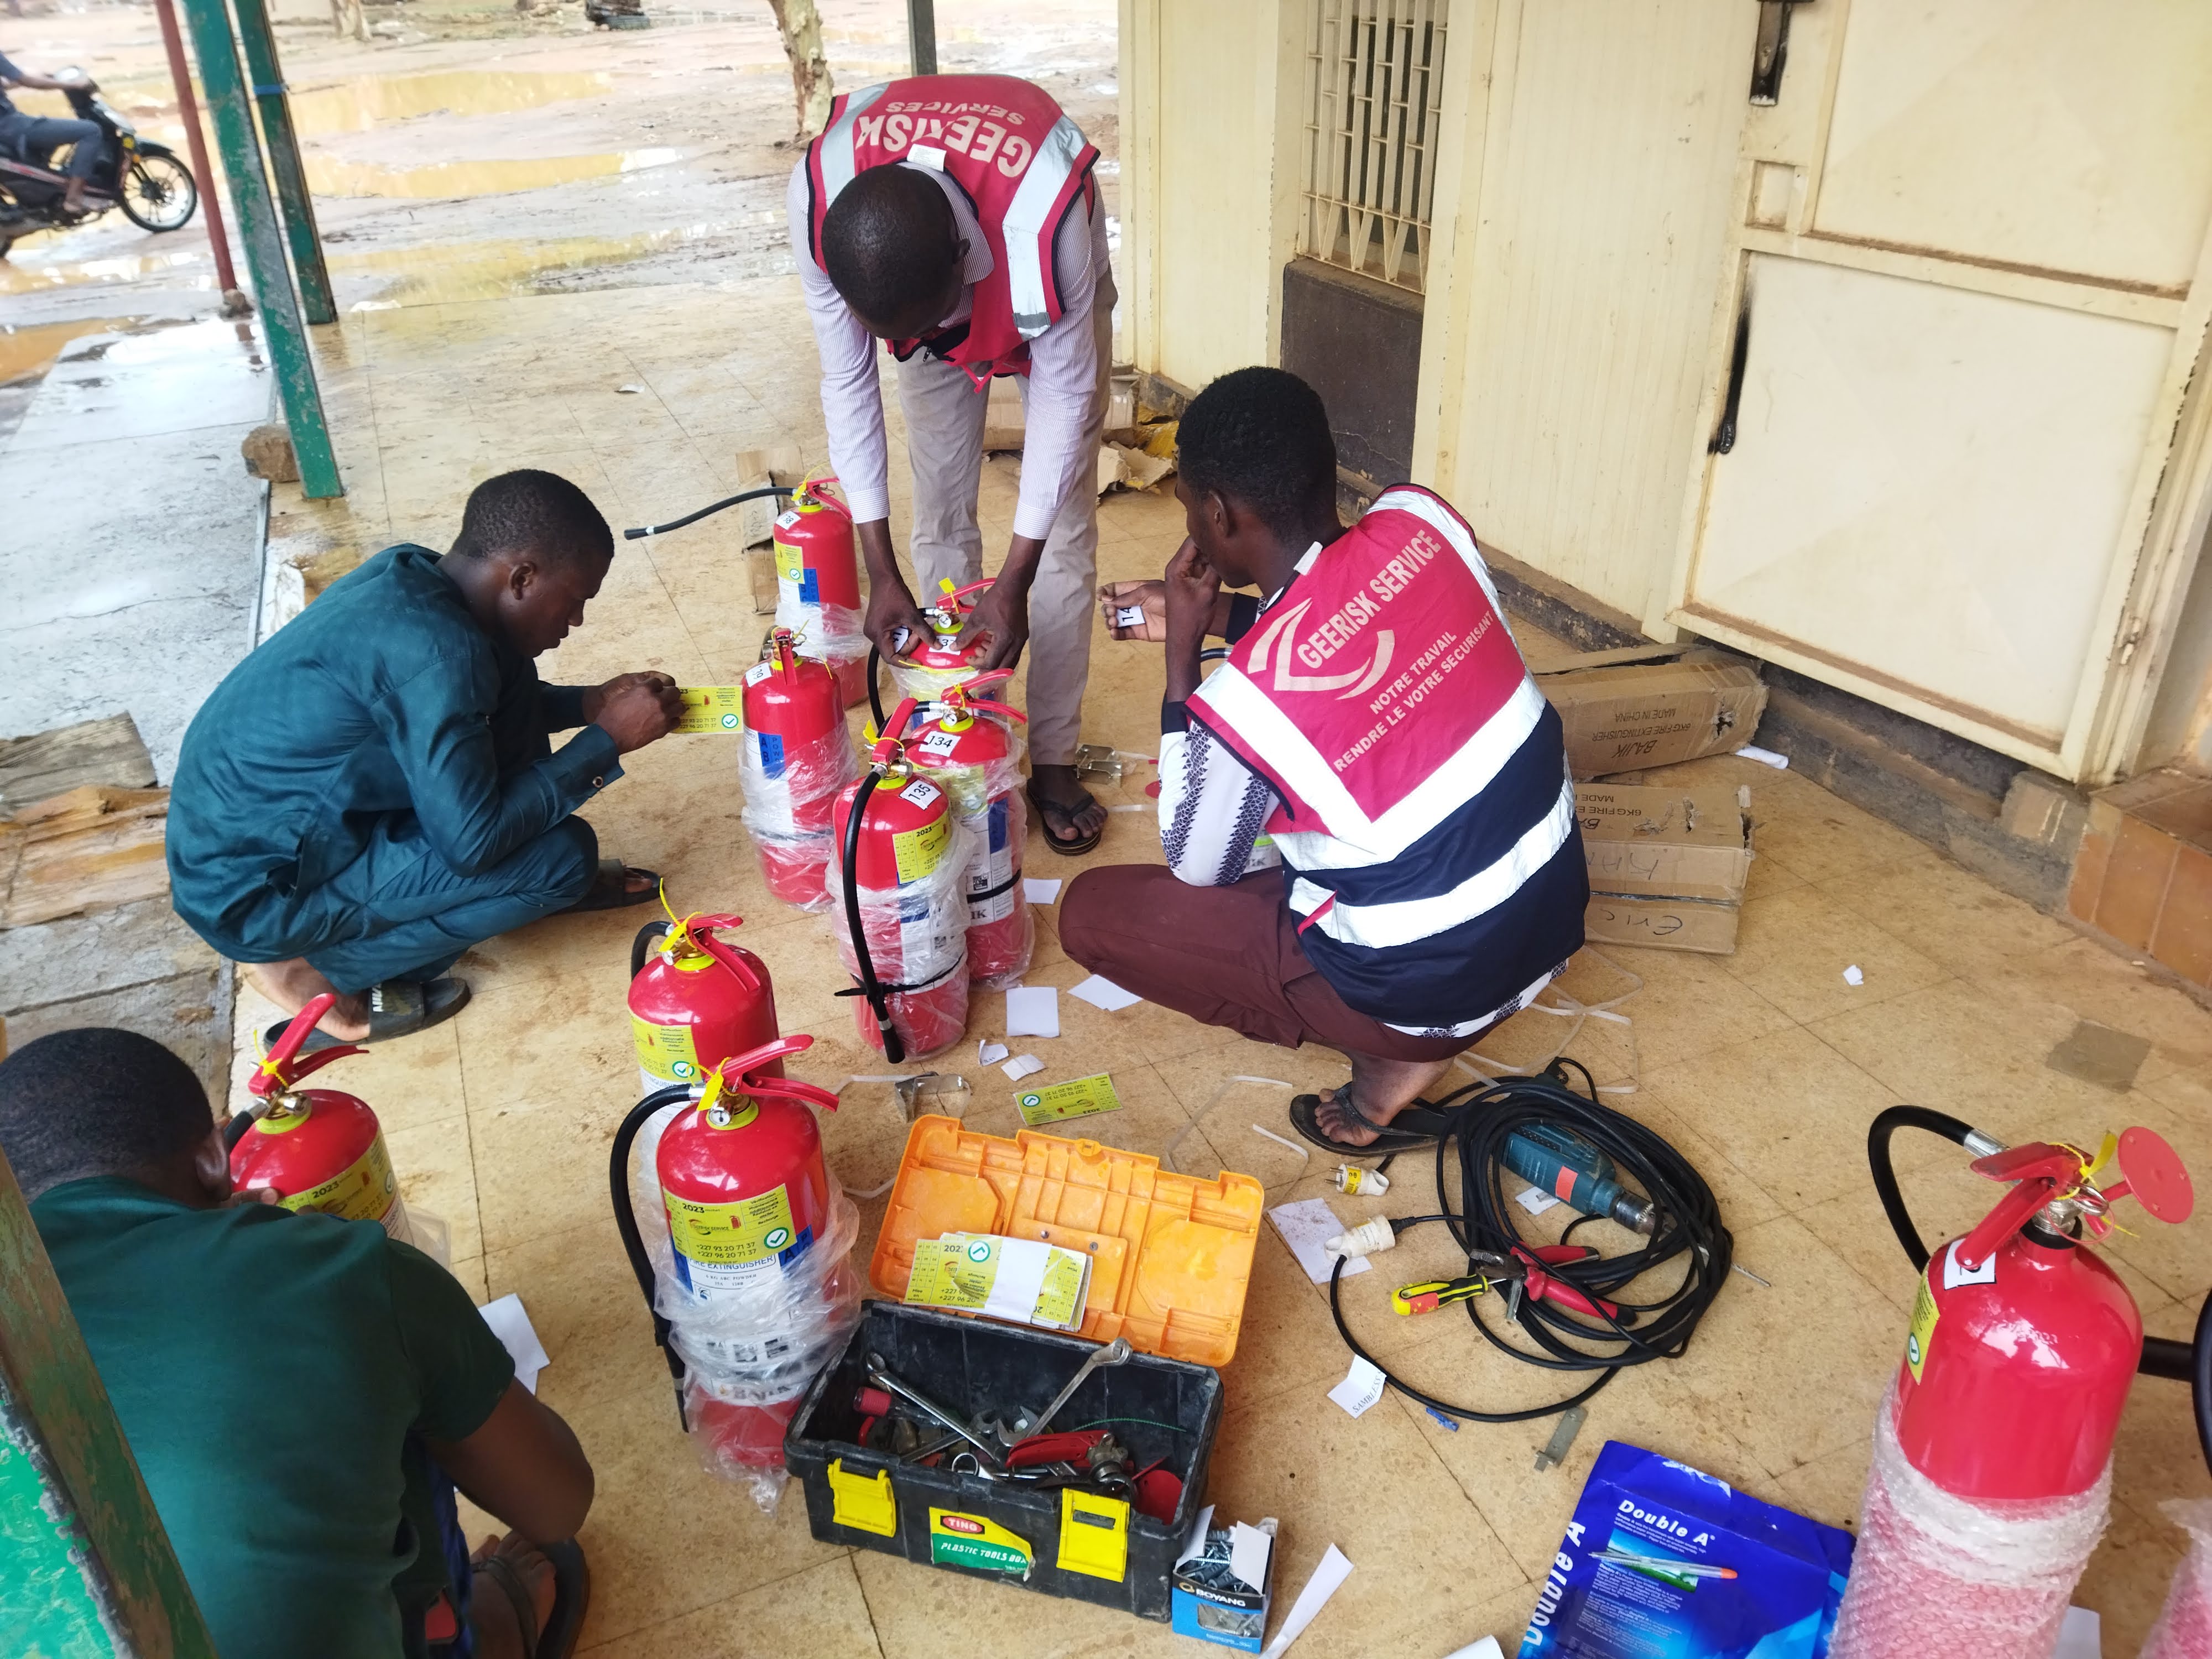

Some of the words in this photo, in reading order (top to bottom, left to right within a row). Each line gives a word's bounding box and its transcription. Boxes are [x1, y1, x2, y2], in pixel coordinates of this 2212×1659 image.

[886, 101, 1026, 125] SERVICES
[1297, 590, 1381, 669] GEERISK
[1370, 529, 1442, 602] SERVICE
[1120, 607, 1134, 622] 14
[1369, 674, 1413, 714] NOTRE
[1410, 630, 1457, 677] TRAVAIL
[1334, 723, 1387, 772] RENDRE
[1386, 705, 1406, 726] LE
[1404, 669, 1444, 707] VOTRE
[1441, 610, 1495, 675] SECURISANT
[1615, 711, 1640, 722] CHINA
[1642, 710, 1652, 719] IN
[1653, 708, 1676, 718] MADE
[929, 735, 953, 748] 134
[1592, 727, 1652, 742] EXTINGUISHER
[1611, 740, 1658, 758] BAJIK
[908, 784, 931, 800] 135
[1582, 794, 1614, 802] MADE
[1589, 806, 1615, 815] FIRE
[916, 826, 932, 837] 2023
[312, 1181, 340, 1198] 2023
[682, 1203, 705, 1213] 2023
[708, 1256, 774, 1270] EXTINGUISHER
[948, 1519, 978, 1531] TING
[1619, 1500, 1688, 1537] Double
[1693, 1532, 1709, 1547] A
[941, 1542, 978, 1554] PLASTIC
[980, 1549, 1007, 1561] TOOLS
[1009, 1554, 1026, 1564] BOX
[1523, 1552, 1573, 1646] Double
[1567, 1521, 1585, 1547] A
[1196, 1588, 1246, 1606] BOYANG
